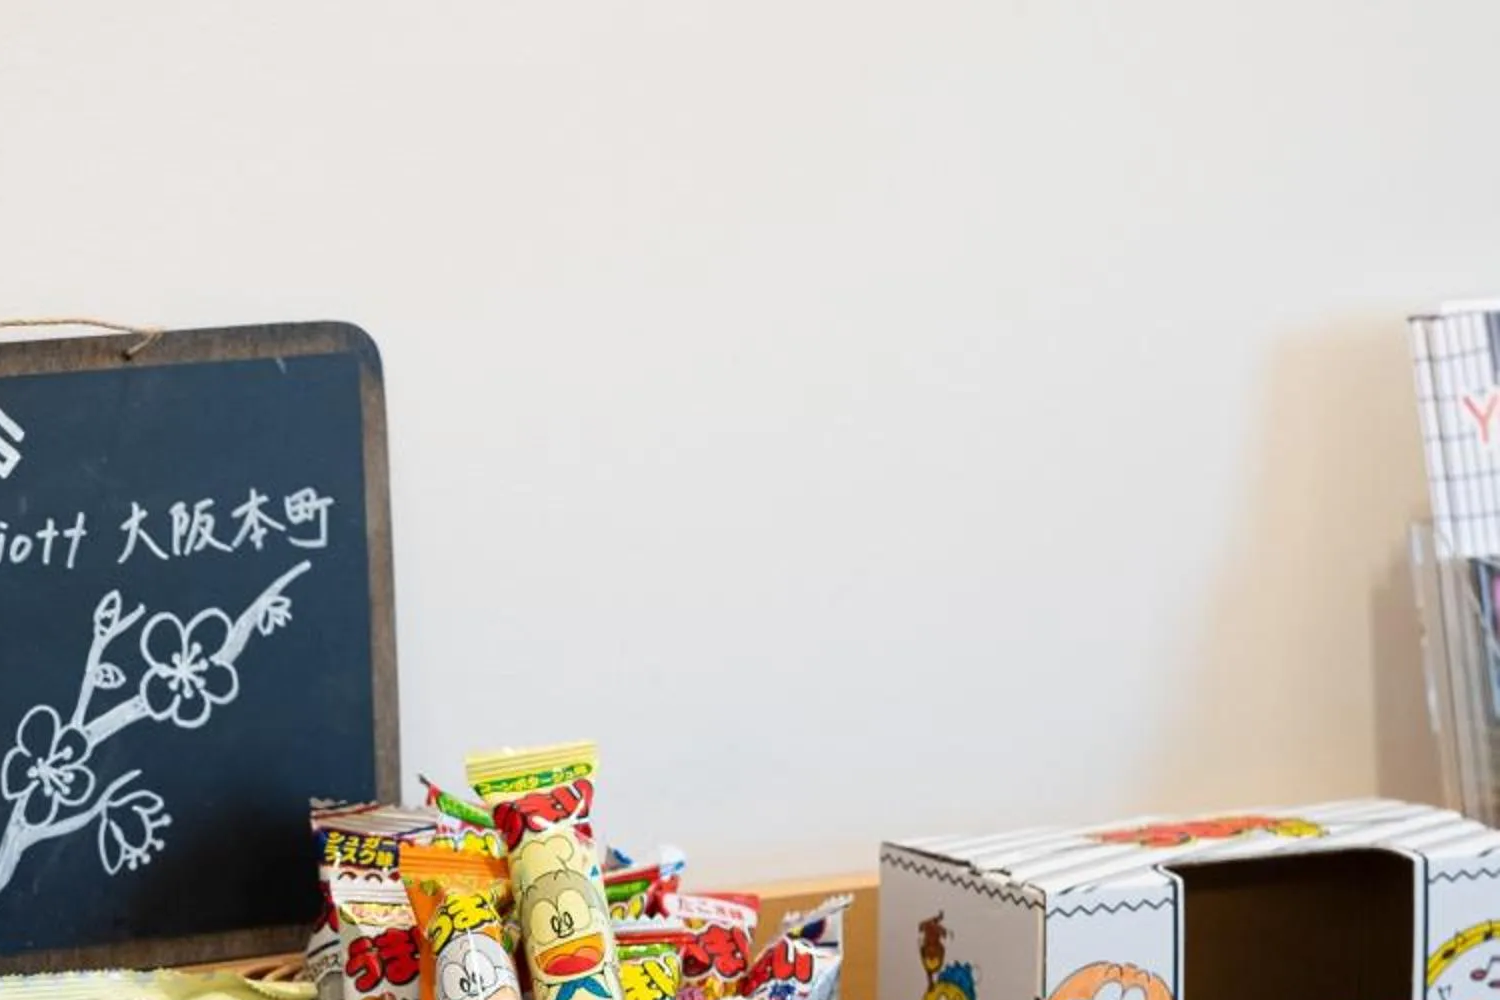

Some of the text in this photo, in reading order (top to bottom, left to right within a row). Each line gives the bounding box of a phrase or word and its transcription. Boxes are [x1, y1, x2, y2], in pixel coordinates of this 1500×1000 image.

[116, 486, 336, 564] 大阪本町
[345, 926, 422, 993] うま
